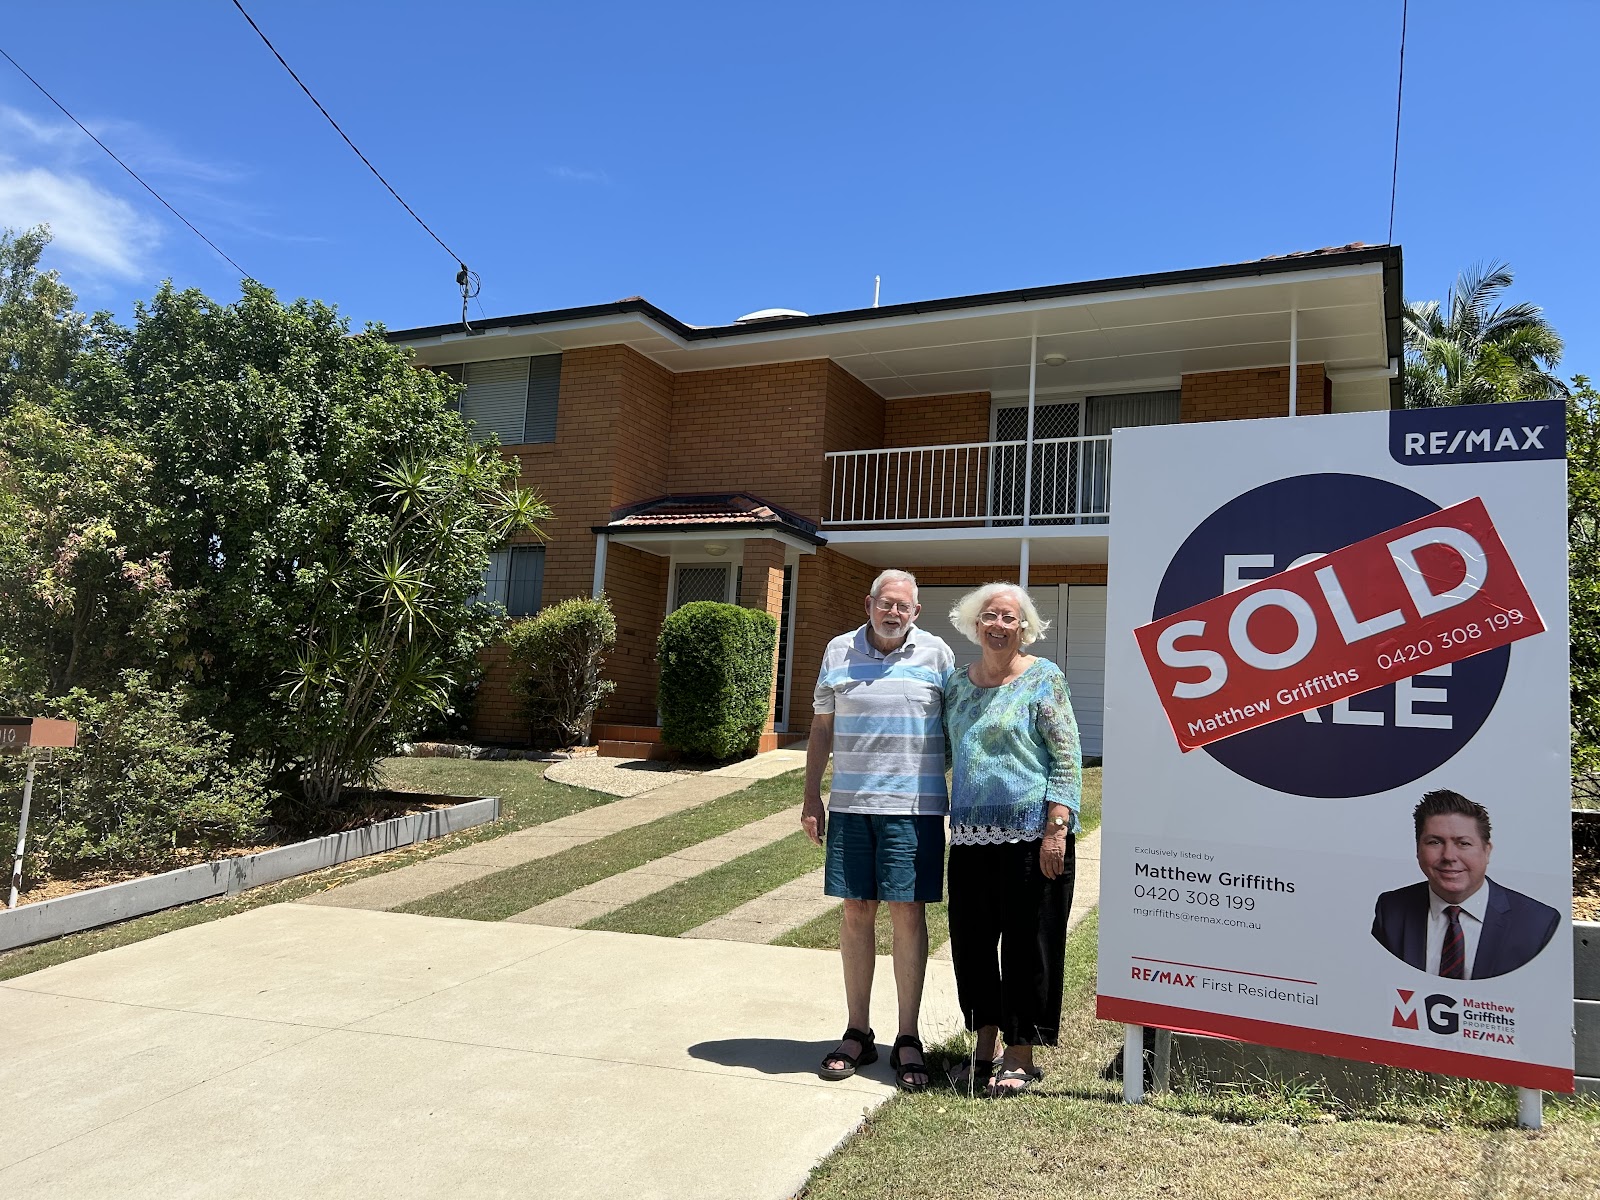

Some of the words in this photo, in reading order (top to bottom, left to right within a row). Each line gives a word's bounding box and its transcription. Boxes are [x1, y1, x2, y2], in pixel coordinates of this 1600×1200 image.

[1404, 425, 1545, 456] RE/MAX
[1156, 526, 1488, 699] SOLD
[1187, 699, 1271, 737] Matthew
[1276, 667, 1360, 706] Griffiths
[1377, 639, 1433, 671] 0420
[1440, 622, 1482, 650] 308
[1489, 608, 1525, 633] 199
[1134, 846, 1178, 858] Exclusively
[1180, 851, 1202, 860] listed
[1204, 853, 1215, 862] by
[1135, 862, 1212, 884] Matthew
[1218, 872, 1296, 893] Griffiths
[1134, 884, 1180, 902] 0420
[1185, 890, 1220, 907] 308
[1225, 895, 1256, 911] 199
[1133, 906, 1262, 930] mgriffiths@remax.com.au
[1131, 966, 1196, 988] RE/MAX
[1202, 977, 1234, 993] First
[1238, 983, 1319, 1006] Residential
[1463, 998, 1515, 1013] Matthew
[1463, 1010, 1515, 1025] Griffiths
[1463, 1020, 1515, 1033] PROPERTIES
[1463, 1028, 1515, 1045] RE/MAX
